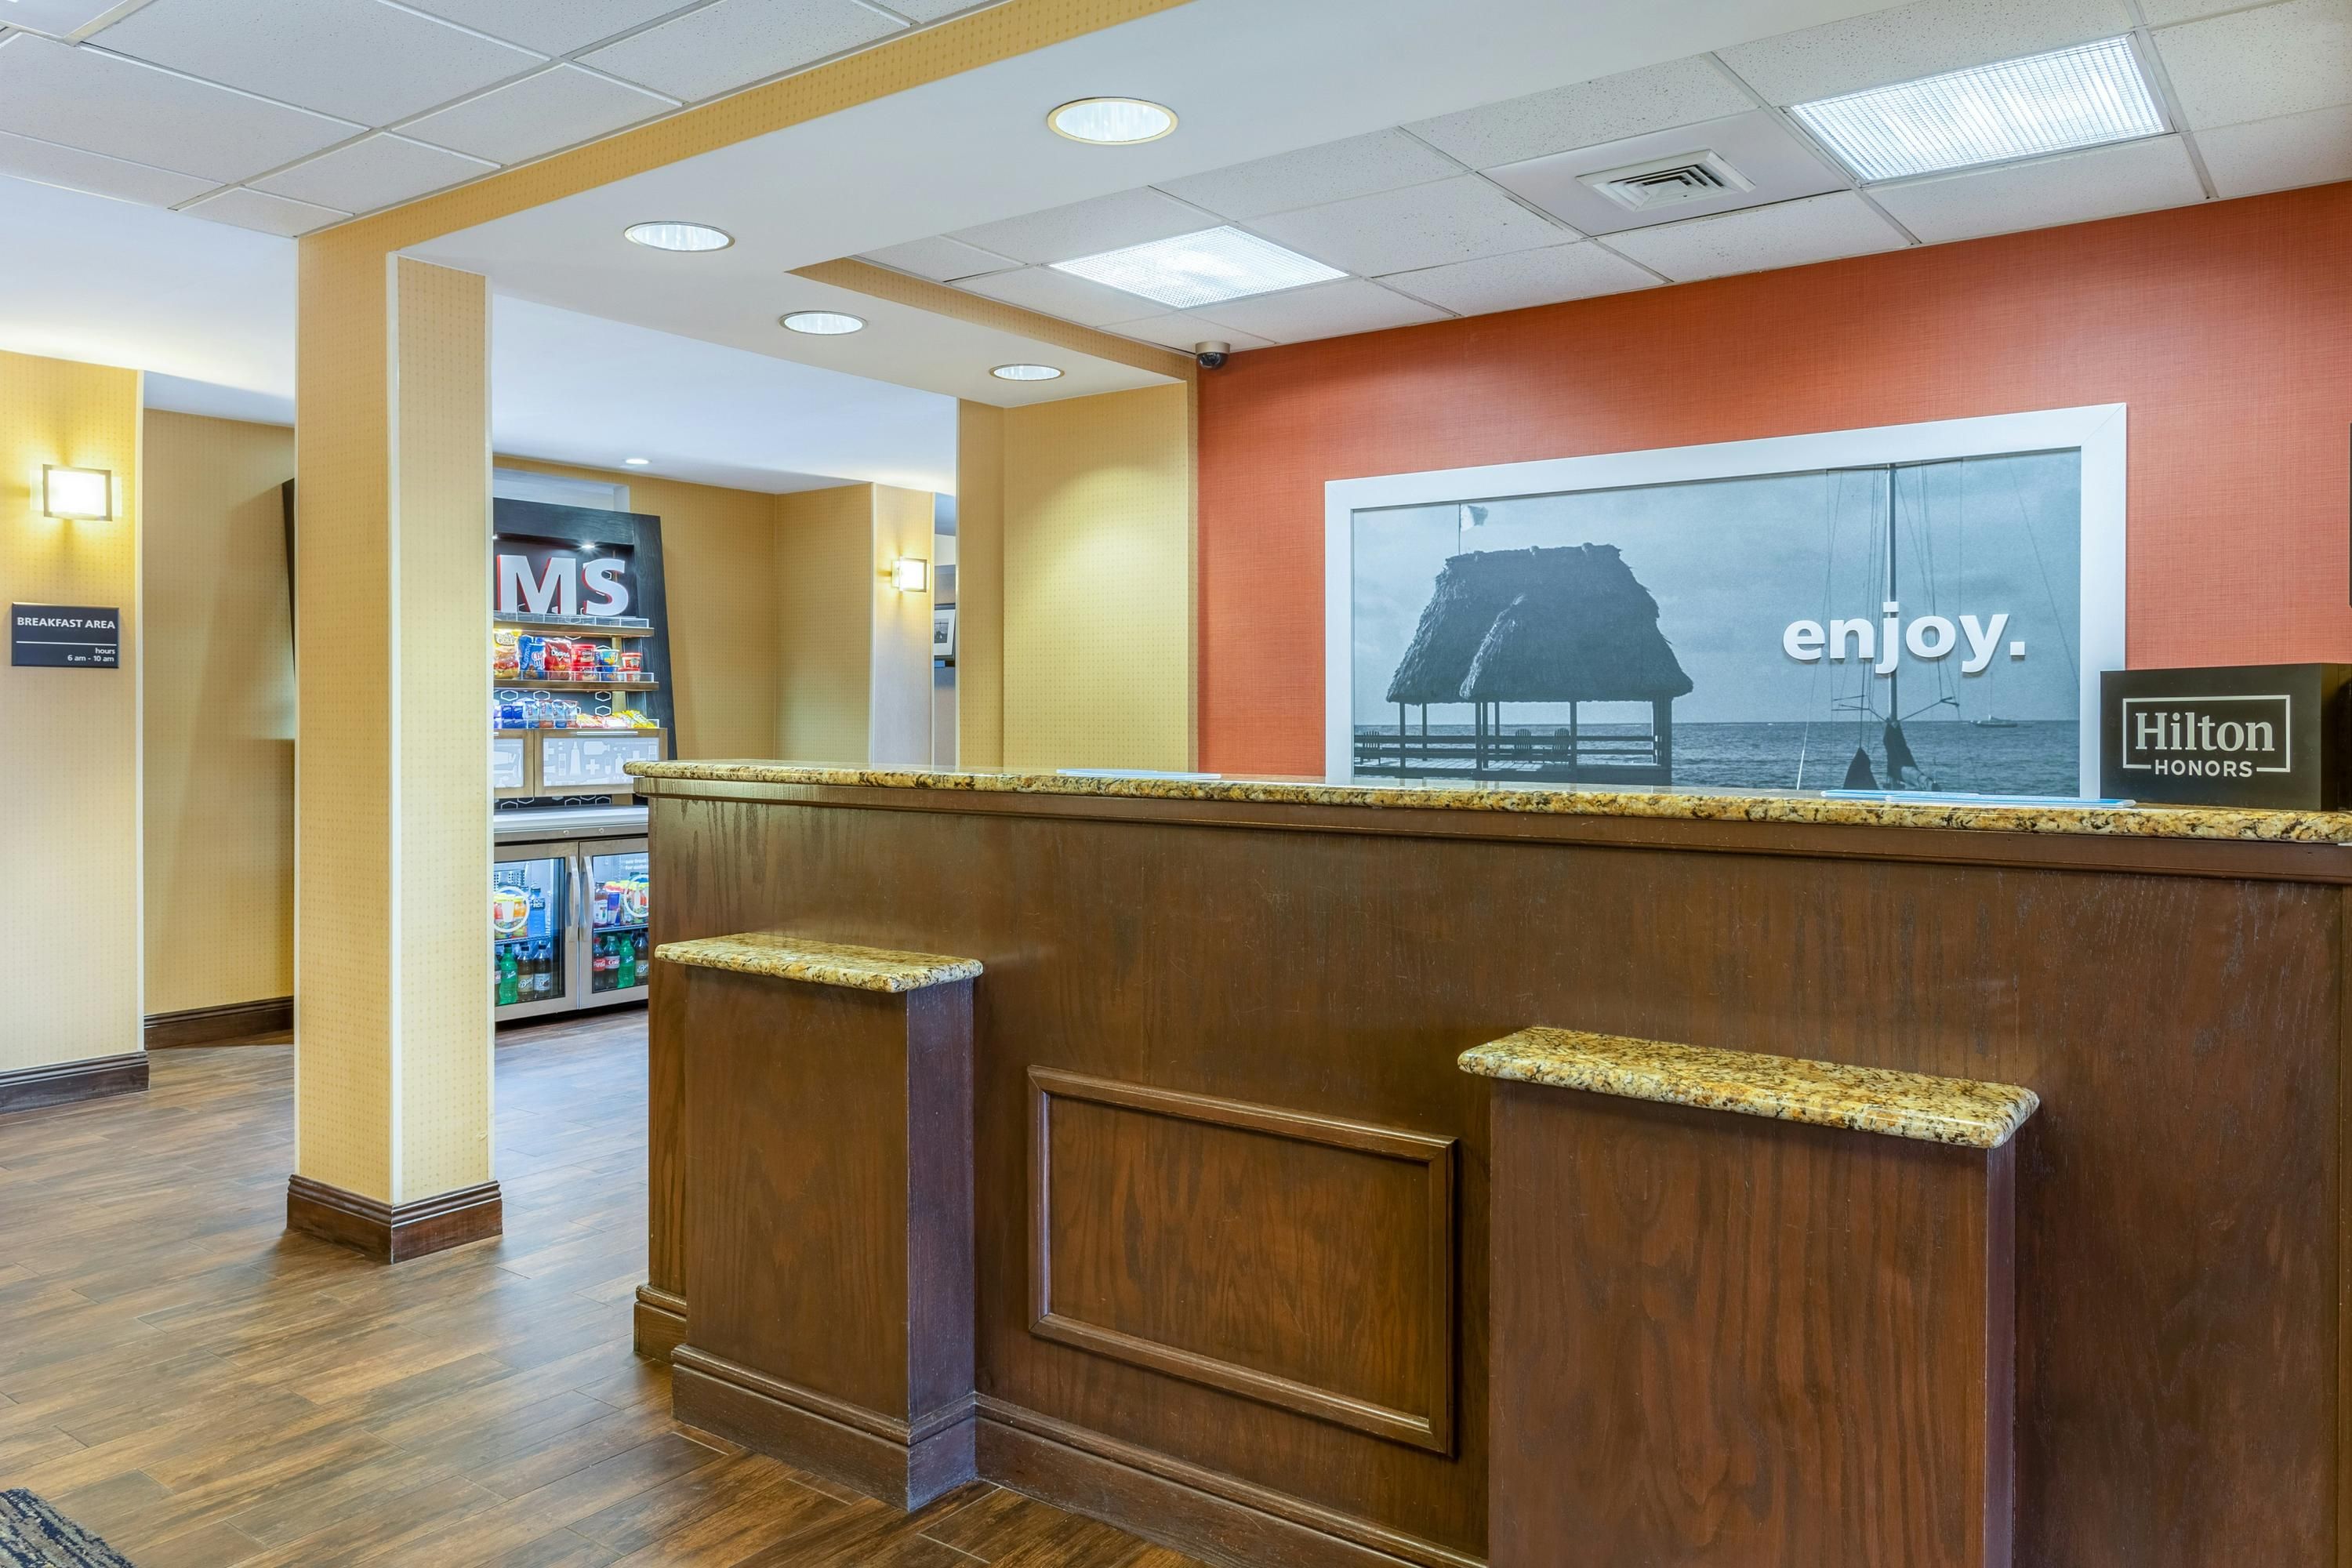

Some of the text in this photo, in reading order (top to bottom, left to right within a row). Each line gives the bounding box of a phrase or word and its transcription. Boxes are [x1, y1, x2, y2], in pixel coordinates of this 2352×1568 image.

[16, 617, 116, 630] BREAKFAST AREA
[1782, 601, 2027, 674] enjoy.
[2135, 711, 2276, 753] Hilton
[2154, 759, 2254, 779] HONORS
